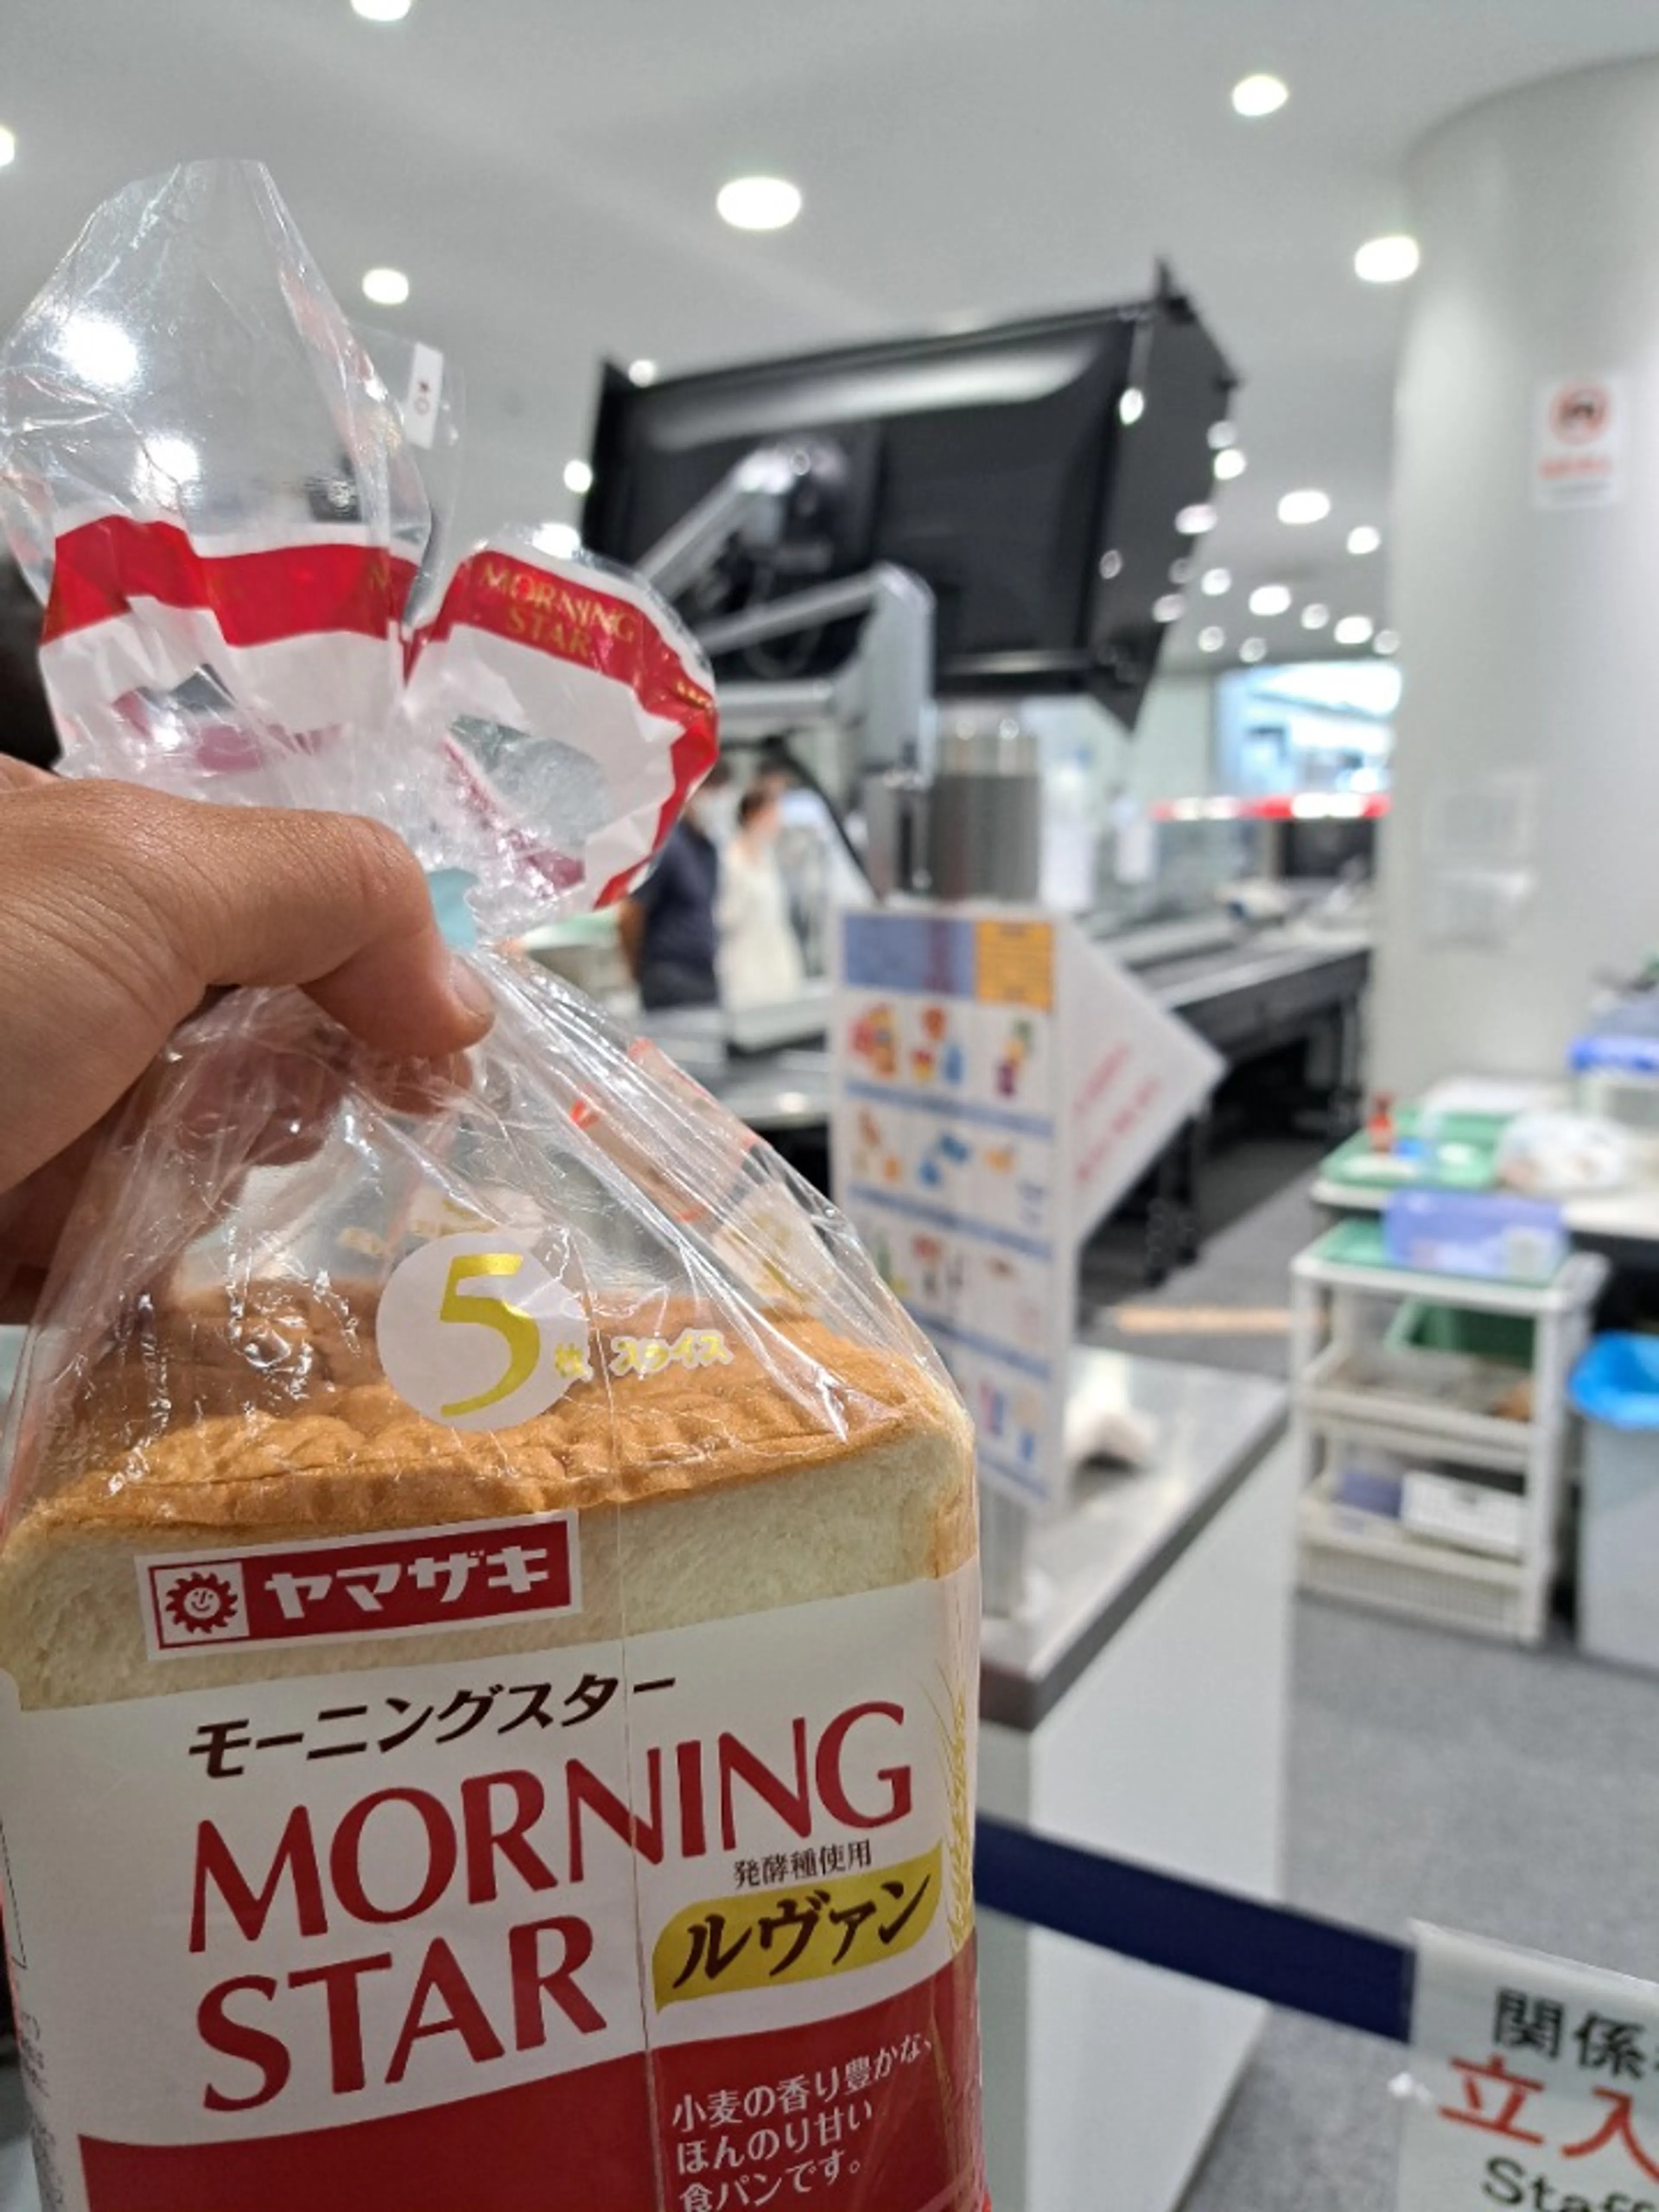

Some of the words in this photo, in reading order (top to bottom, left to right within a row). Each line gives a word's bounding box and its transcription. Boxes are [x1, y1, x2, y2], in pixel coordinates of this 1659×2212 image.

[480, 563, 637, 644] MORNING
[507, 607, 590, 658] STAR
[440, 1252, 540, 1419] 5
[265, 1545, 550, 1619] ヤマザキ
[189, 1673, 676, 1778] モーニングスター
[188, 1700, 913, 1954] MORNING
[734, 1839, 873, 1889] 発酵種使用
[672, 1873, 931, 1988] ルヴァン
[197, 1914, 607, 2113] STAR
[1492, 1986, 1659, 2082] 関係
[677, 2100, 873, 2175] ほんのり甘い
[679, 2149, 860, 2212] 食パンです。
